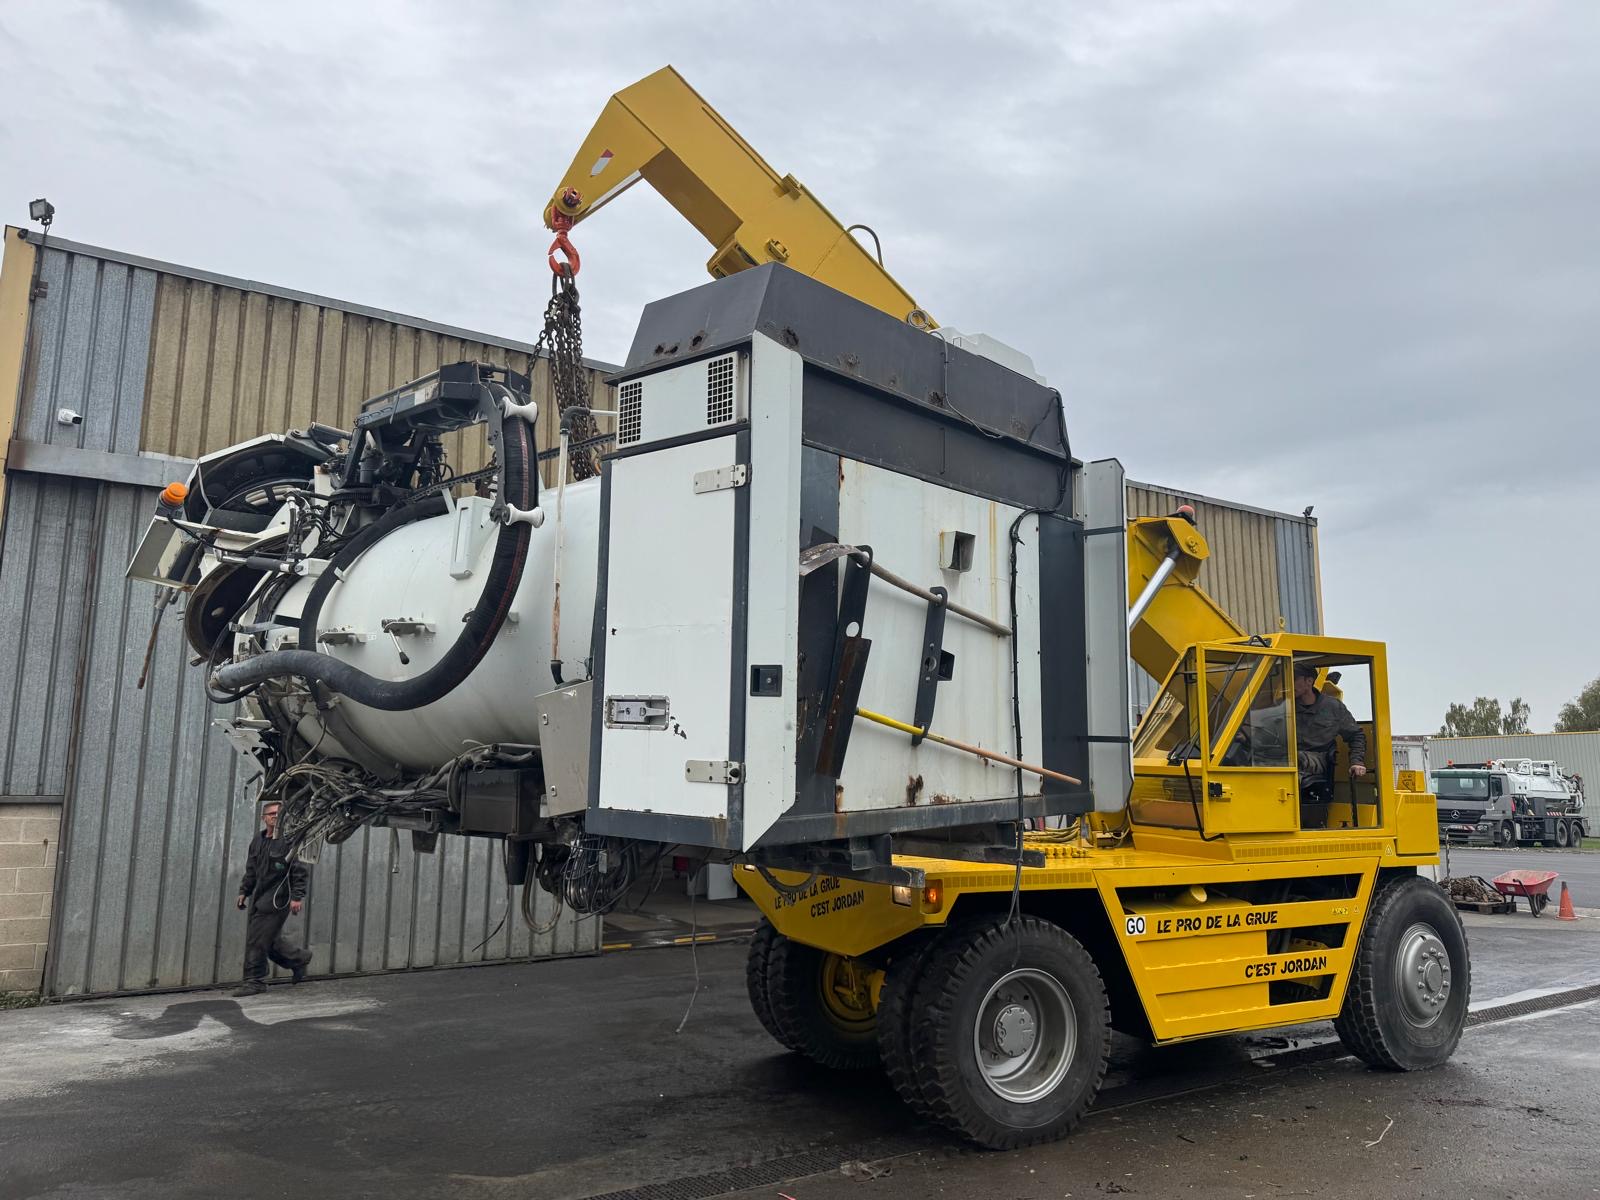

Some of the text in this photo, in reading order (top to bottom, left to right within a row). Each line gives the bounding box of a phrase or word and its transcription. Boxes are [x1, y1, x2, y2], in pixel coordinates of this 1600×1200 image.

[774, 896, 781, 909] LE
[809, 883, 818, 897] LA
[820, 876, 840, 893] GRUE
[811, 889, 864, 917] C'EST JORDAN
[1157, 910, 1278, 934] LE PRO DE LA GRUE
[1245, 956, 1327, 978] C'EST JORDAN
